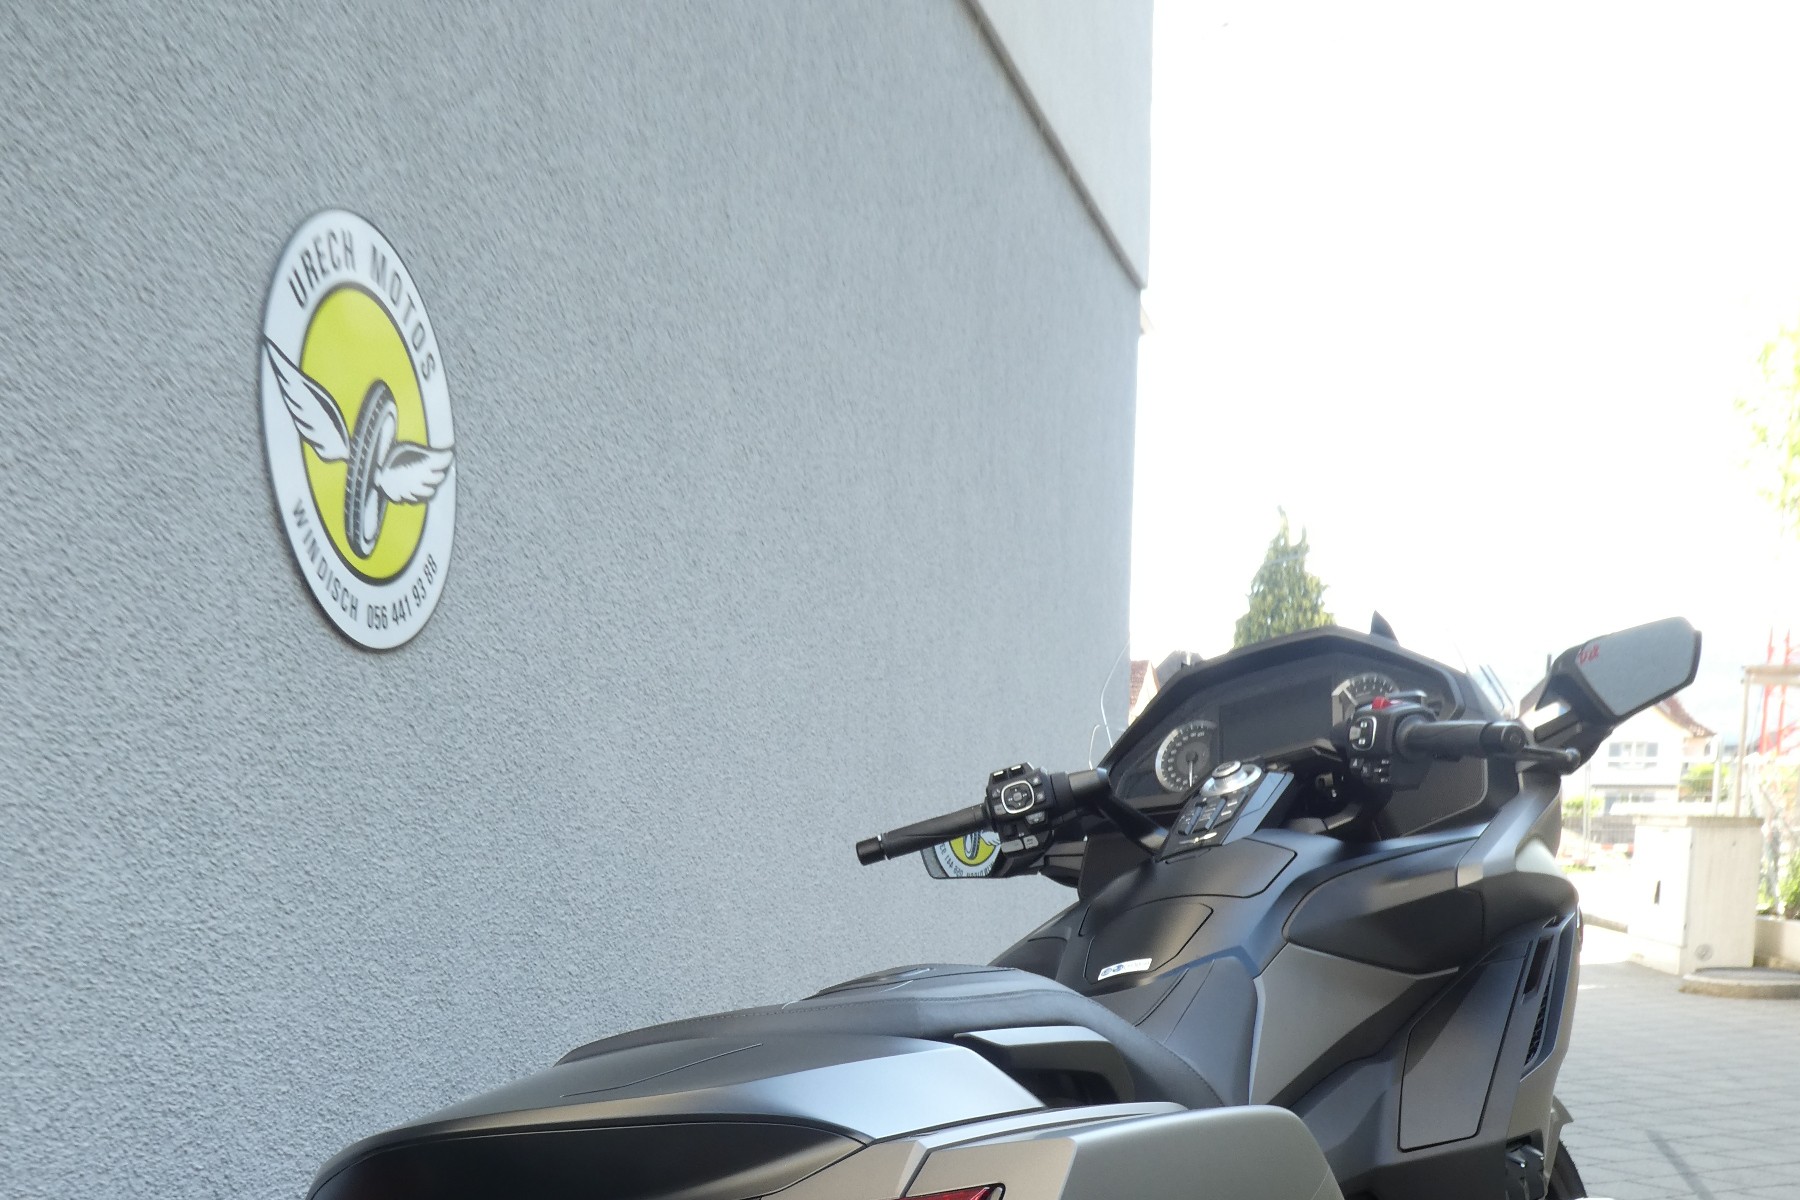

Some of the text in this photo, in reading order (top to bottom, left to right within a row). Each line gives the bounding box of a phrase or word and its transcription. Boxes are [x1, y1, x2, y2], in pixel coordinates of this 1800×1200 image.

[287, 229, 436, 382] URECH MOTOS
[293, 499, 359, 622] WINDISCH
[366, 604, 388, 630] 056
[391, 594, 413, 626] 441
[412, 577, 428, 608] 93
